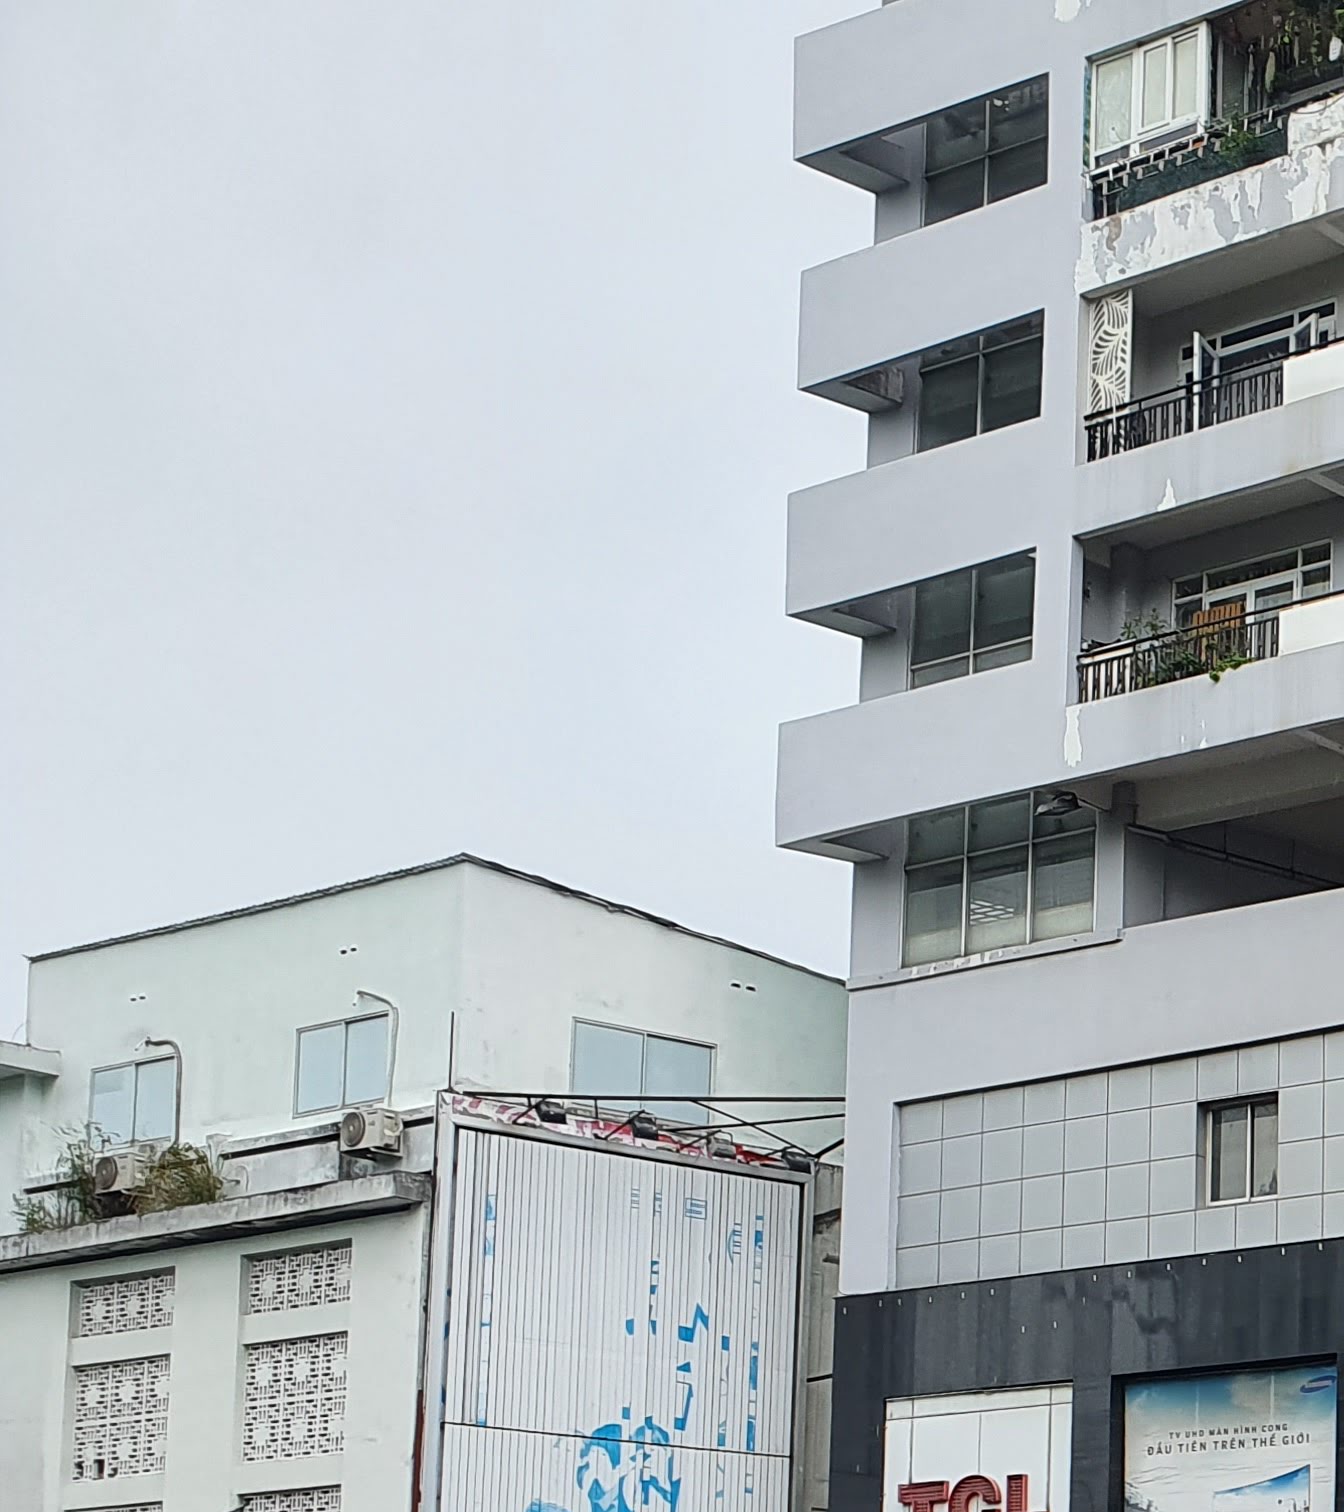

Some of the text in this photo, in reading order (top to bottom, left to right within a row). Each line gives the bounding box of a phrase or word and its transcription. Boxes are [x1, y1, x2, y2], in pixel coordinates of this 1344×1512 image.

[1169, 1423, 1288, 1440] TV UHD MÀN HÌNH CONG
[1147, 1431, 1311, 1456] ĐẦU TIÊN TRÊN THẾ GIỚI
